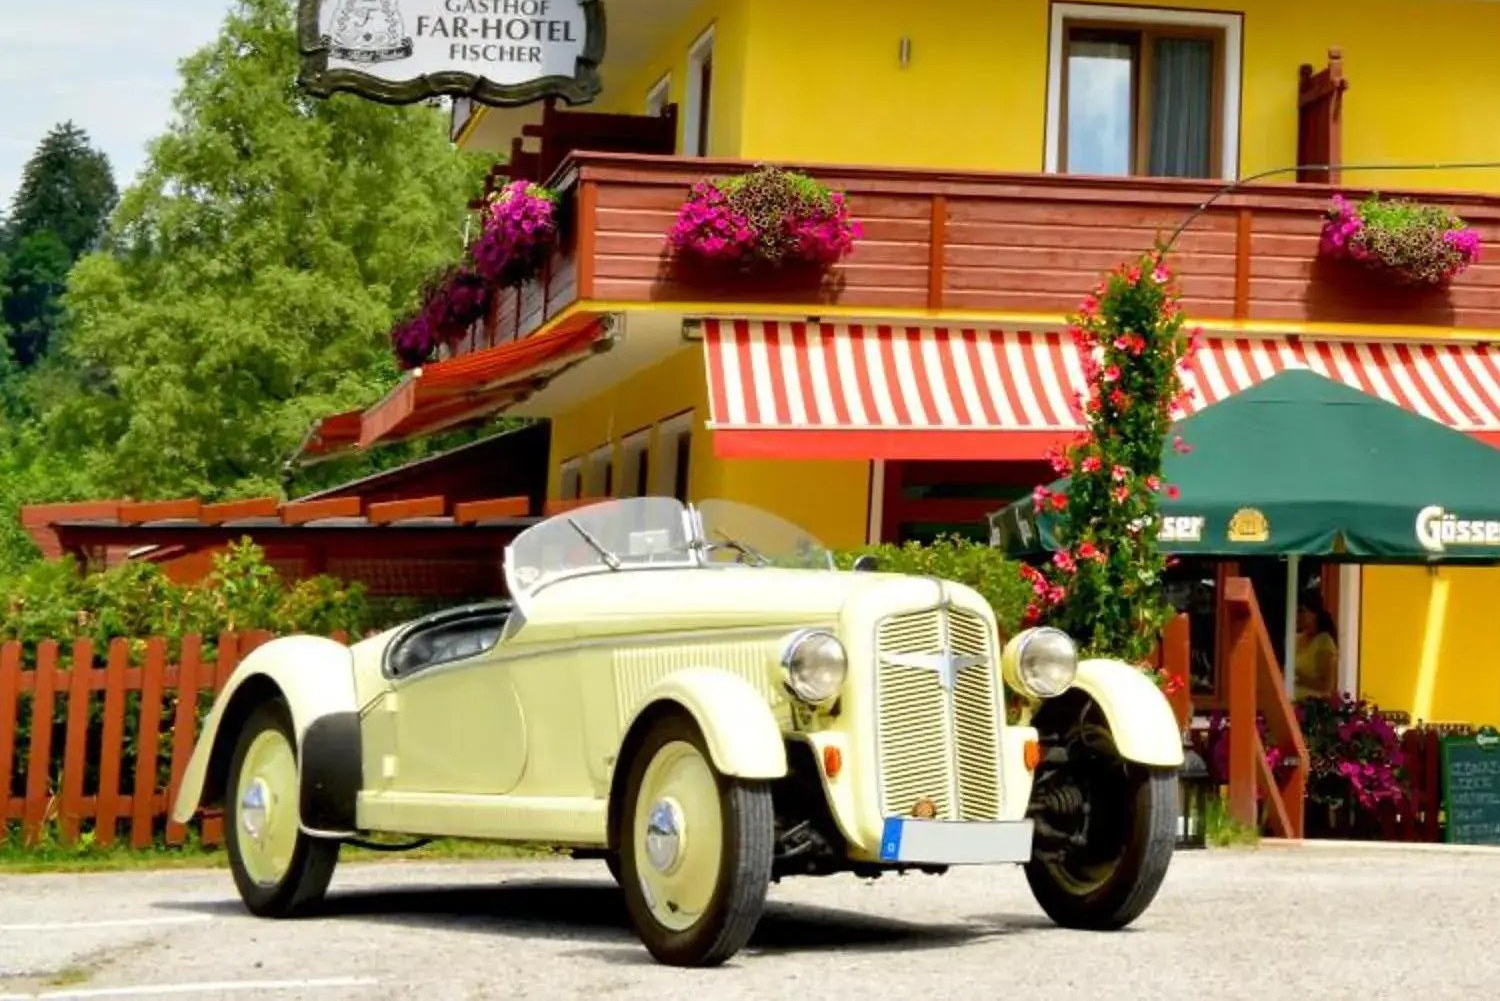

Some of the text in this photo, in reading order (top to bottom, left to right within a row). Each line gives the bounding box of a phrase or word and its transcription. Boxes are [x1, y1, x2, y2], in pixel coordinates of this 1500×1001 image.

[416, 14, 577, 43] FAR-HOTEL
[449, 43, 543, 64] FISCHER
[1154, 515, 1206, 542] ser
